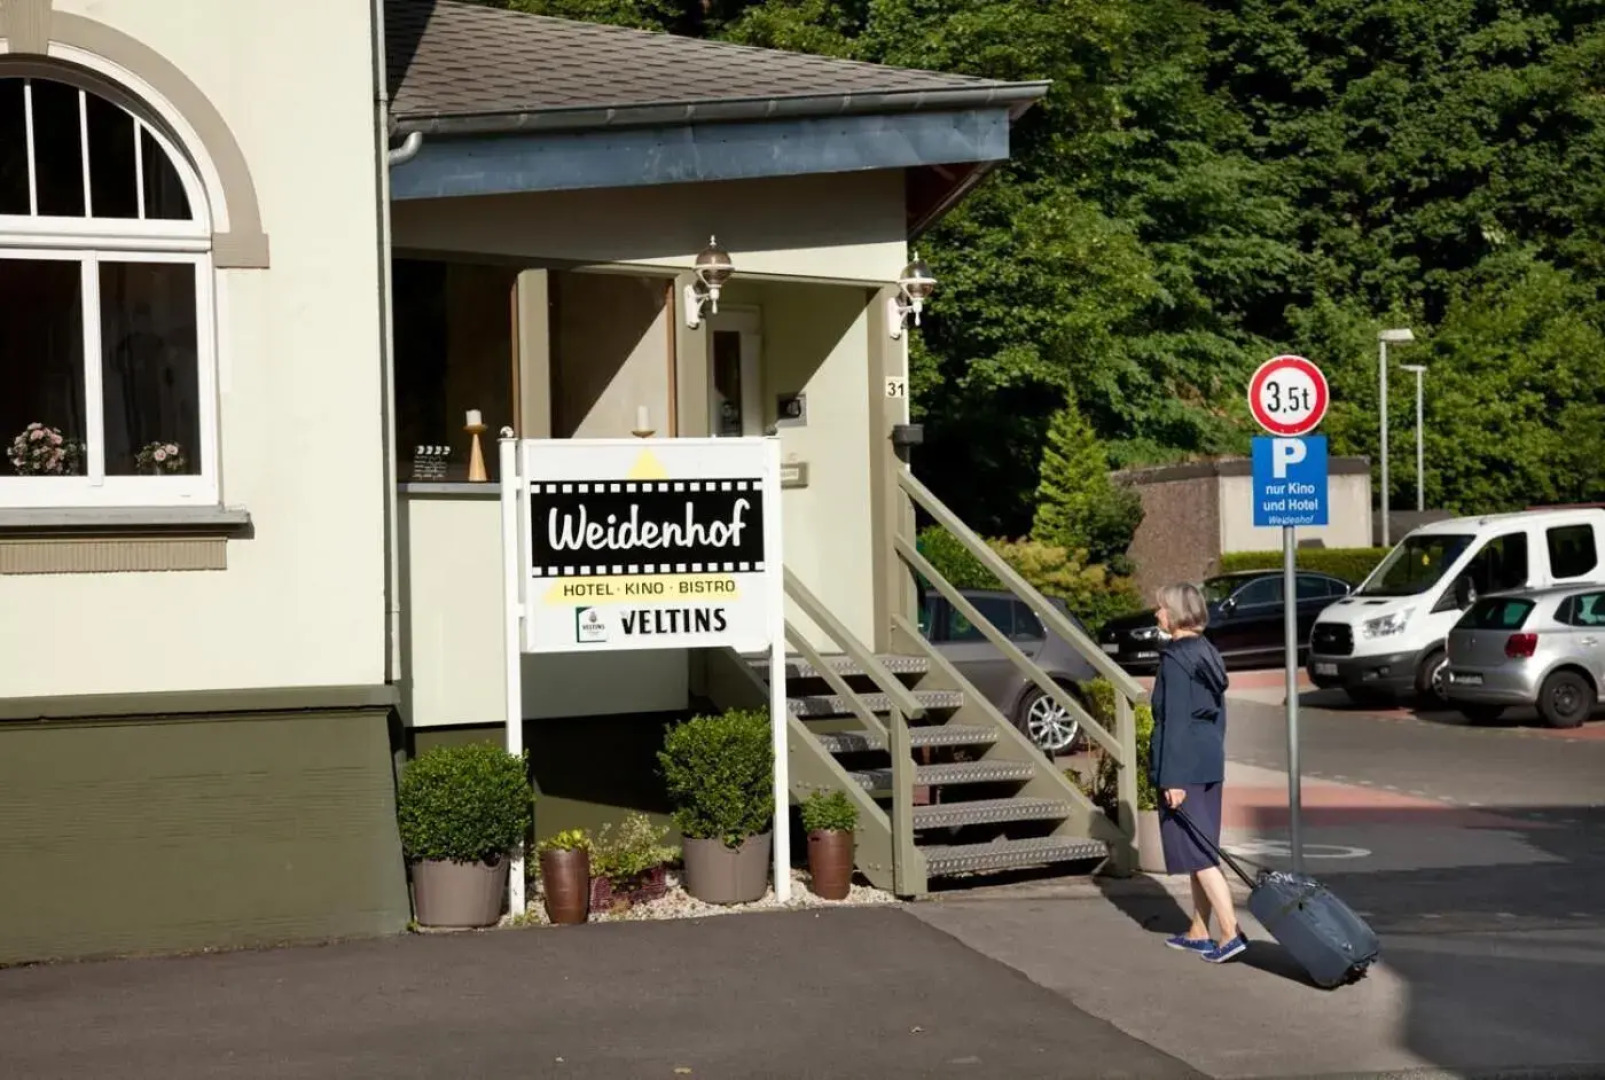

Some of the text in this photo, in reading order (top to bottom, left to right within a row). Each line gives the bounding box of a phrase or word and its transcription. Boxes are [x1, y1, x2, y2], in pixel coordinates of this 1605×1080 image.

[888, 382, 904, 397] 31
[1272, 438, 1307, 479] P
[1266, 482, 1316, 495] nur Kino
[1263, 498, 1319, 511] und Hotel
[548, 498, 750, 550] Weidenhof
[563, 580, 736, 597] HOTEL KINO BISTRO
[621, 607, 727, 635] VELTINS
